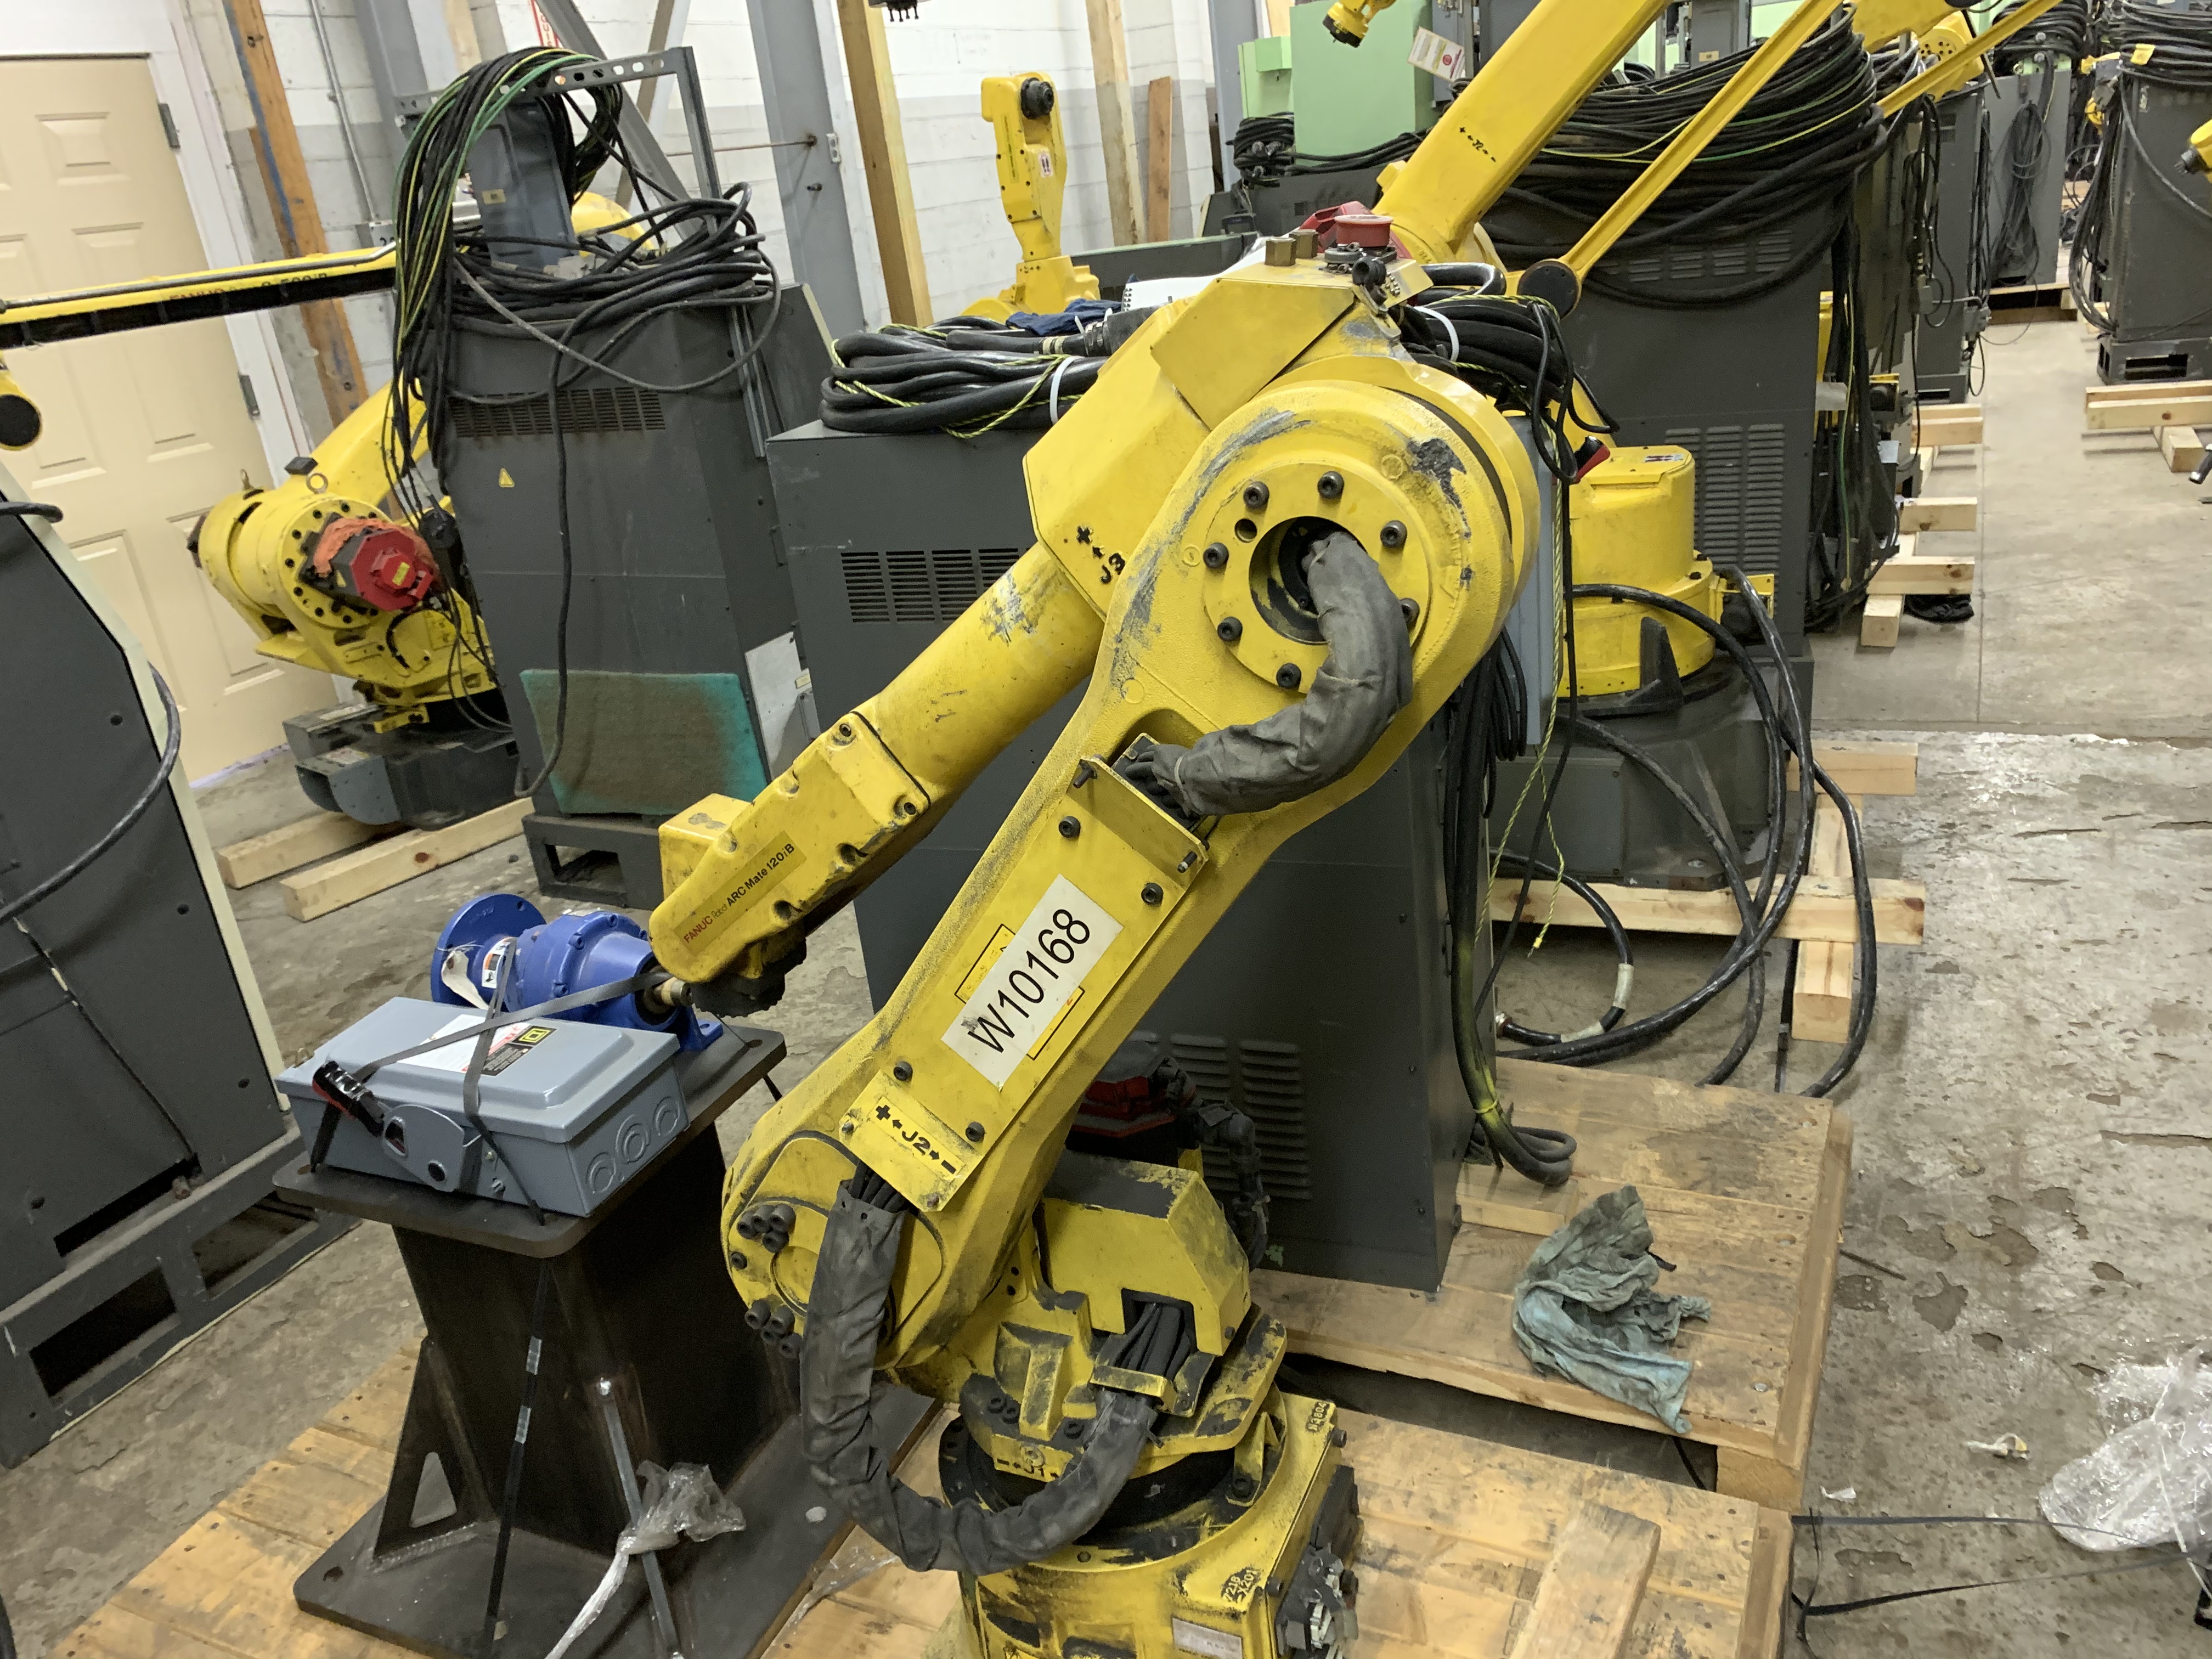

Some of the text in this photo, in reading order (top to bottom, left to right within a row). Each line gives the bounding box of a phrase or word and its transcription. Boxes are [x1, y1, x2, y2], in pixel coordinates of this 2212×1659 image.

[684, 916, 713, 943] FANUC
[712, 904, 729, 919] Robot
[726, 887, 746, 906] ARC
[745, 871, 768, 890] Mate
[967, 909, 1090, 1053] W10168
[902, 1131, 931, 1155] J2
